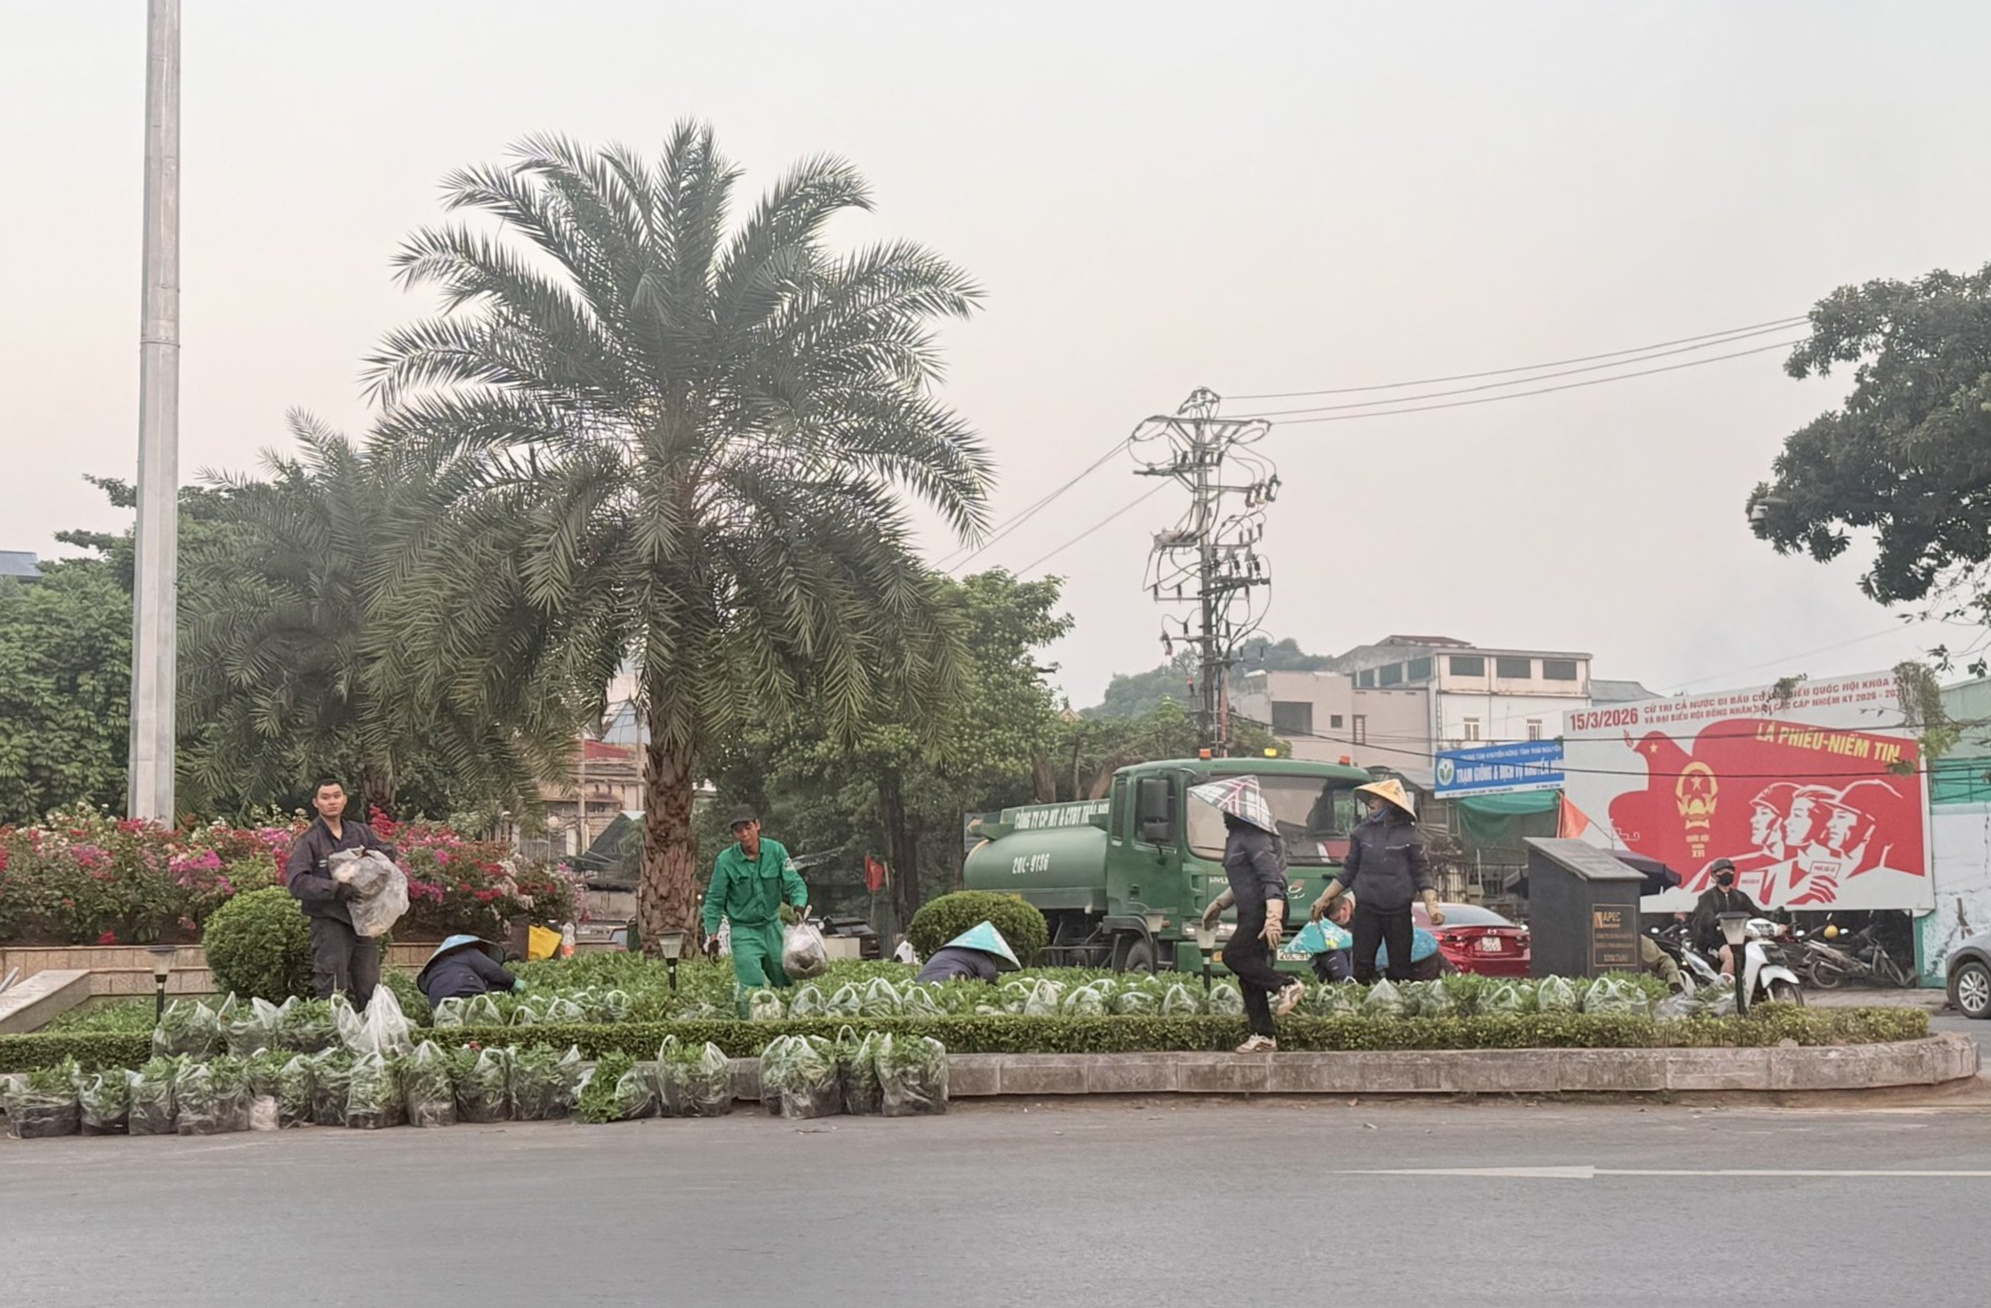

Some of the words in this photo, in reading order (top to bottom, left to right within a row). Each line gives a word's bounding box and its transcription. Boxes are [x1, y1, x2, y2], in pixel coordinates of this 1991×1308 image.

[1659, 704, 1672, 713] TRI
[1812, 684, 1839, 696] QUỐC
[1842, 681, 1859, 692] HỘI
[1570, 708, 1639, 731] 15/3/2026
[1756, 722, 1775, 743] LÁ
[1874, 742, 1901, 764] TIN
